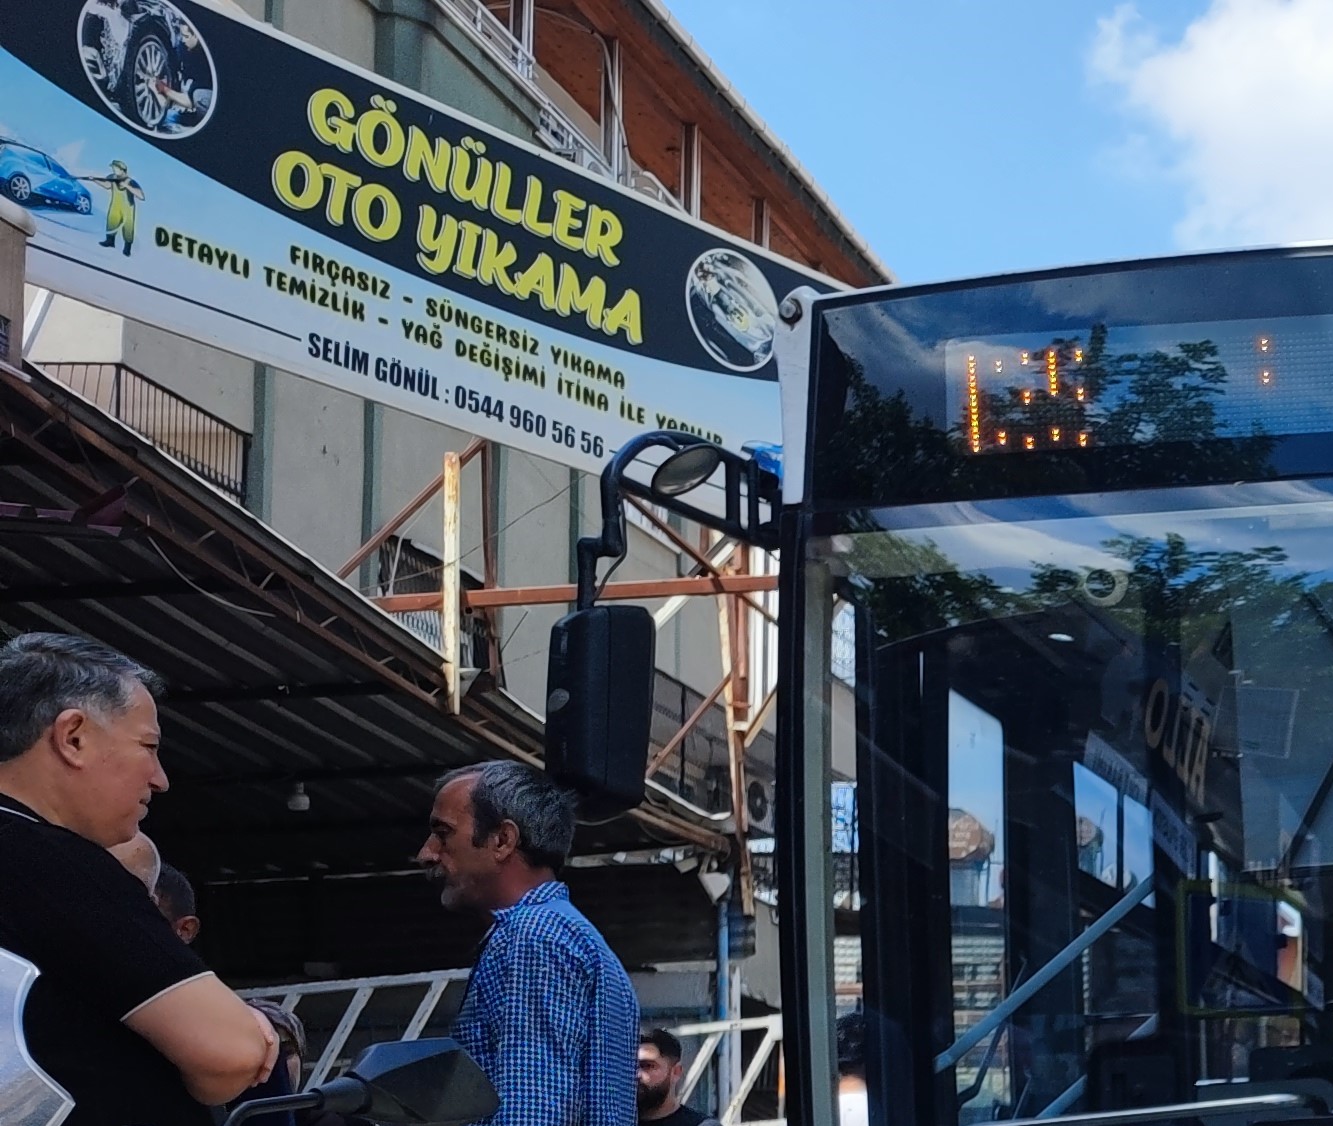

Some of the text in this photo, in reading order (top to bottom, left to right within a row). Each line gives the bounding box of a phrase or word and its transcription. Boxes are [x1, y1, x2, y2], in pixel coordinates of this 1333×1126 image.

[272, 150, 643, 345] OTO YIKAMA
[308, 88, 624, 267] GÖNÜLLER
[155, 226, 250, 279] DETAYLI
[263, 266, 365, 321] TEMİZLİK
[401, 318, 443, 349] YAĞ
[455, 338, 546, 388] DEĞİŞİMİ
[557, 372, 609, 412] İTİNA
[619, 397, 645, 425] İLE
[290, 245, 391, 299] FIRÇASIZ
[425, 297, 540, 356] SÜNGERSİZ
[550, 345, 626, 390] YIKAMA
[308, 333, 369, 376] SELİM
[375, 356, 439, 400] GÖNÜL
[454, 385, 504, 422] 0544
[509, 405, 546, 438] 960
[552, 420, 575, 449] 56
[581, 434, 604, 458] 56
